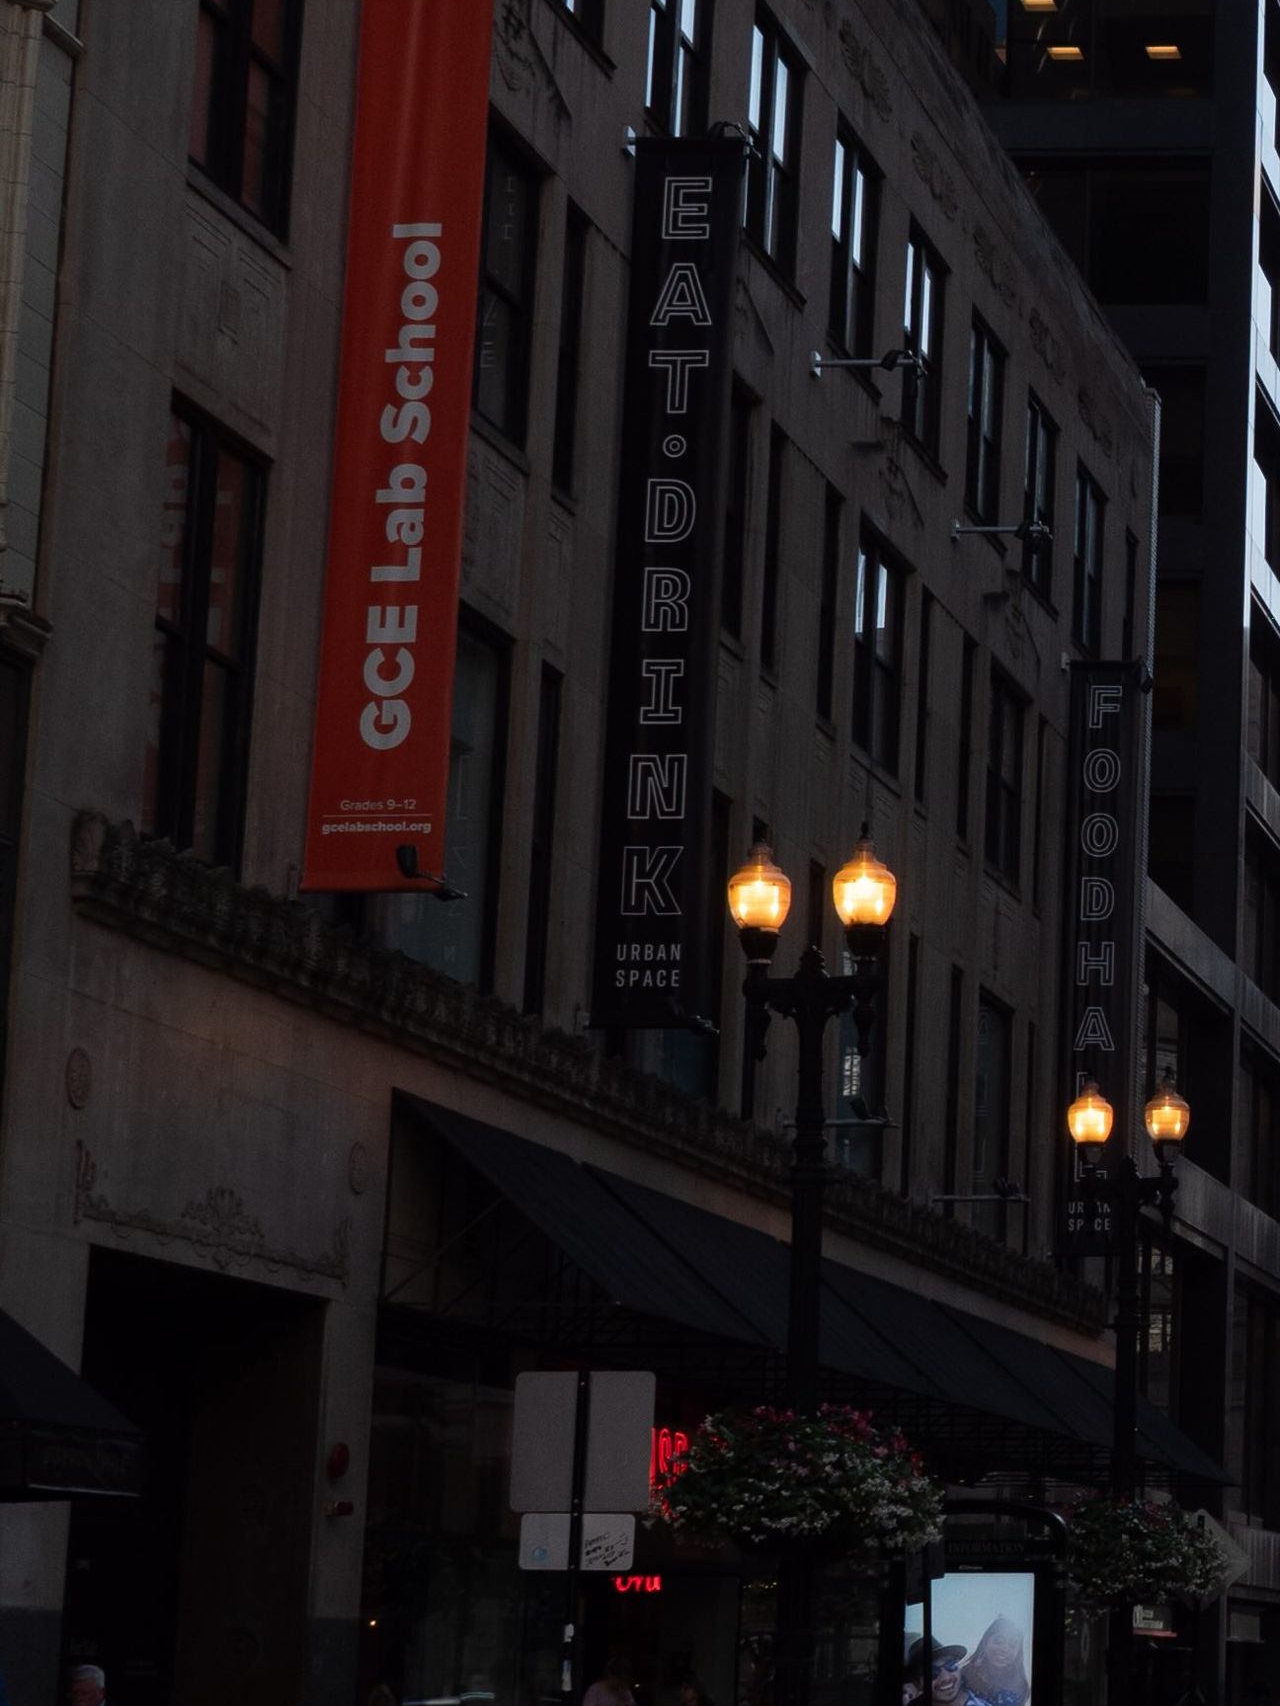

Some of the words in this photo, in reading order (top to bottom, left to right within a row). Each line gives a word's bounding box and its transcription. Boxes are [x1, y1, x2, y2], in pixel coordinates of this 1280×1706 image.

[379, 221, 443, 446] School
[369, 462, 429, 583] Lab
[359, 604, 420, 752] GCE
[339, 798, 384, 811] Grades
[321, 820, 432, 835] gcelabschool.org
[1072, 684, 1124, 1182] FOODHA
[615, 942, 682, 962] URBAN
[614, 967, 681, 988] SPACE
[1066, 1217, 1112, 1232] SPCE
